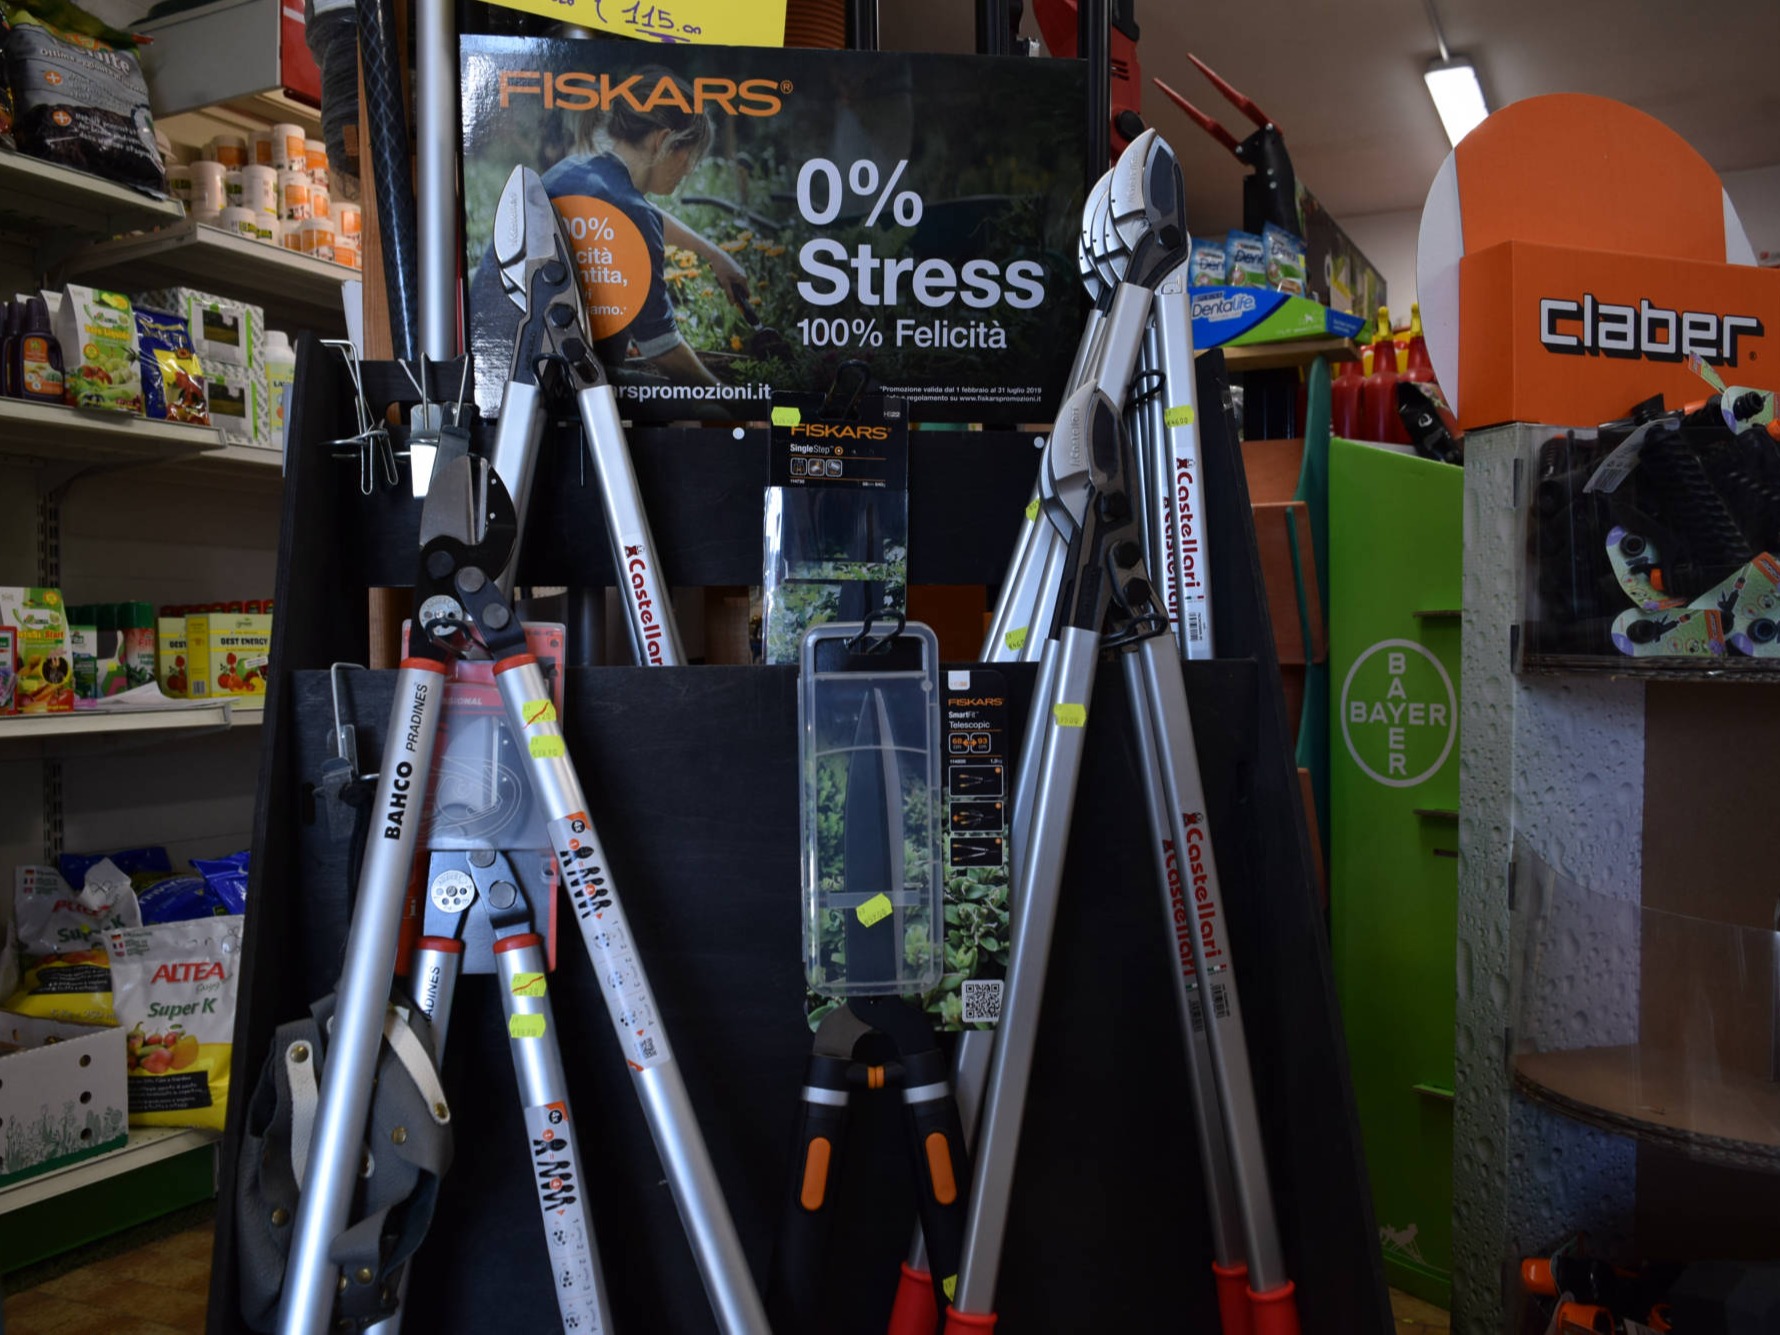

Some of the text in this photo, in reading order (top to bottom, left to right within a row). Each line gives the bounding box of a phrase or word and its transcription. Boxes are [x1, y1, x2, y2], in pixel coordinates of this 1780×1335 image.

[796, 158, 922, 227] 0%
[576, 247, 613, 265] cità
[580, 267, 628, 287] ntita,
[797, 239, 1045, 309] Stress
[796, 318, 1007, 349] 100% Felicità
[1539, 293, 1764, 366] claber
[907, 395, 949, 403] regolamento
[959, 395, 1042, 403] www.fiskarspromozioni.it
[961, 386, 989, 394] febbraio
[1006, 386, 1025, 396] luglio
[1176, 471, 1201, 588] Castellari
[627, 557, 664, 666] Castellar
[405, 684, 429, 753] PRADINES
[949, 720, 991, 730] Telescopic
[1350, 703, 1447, 727] BAYER
[1386, 653, 1407, 777] BAYER
[384, 760, 413, 840] BAHCO
[1186, 827, 1222, 959] Castellari
[150, 961, 225, 984] ALTEA
[148, 998, 218, 1021] Super K
